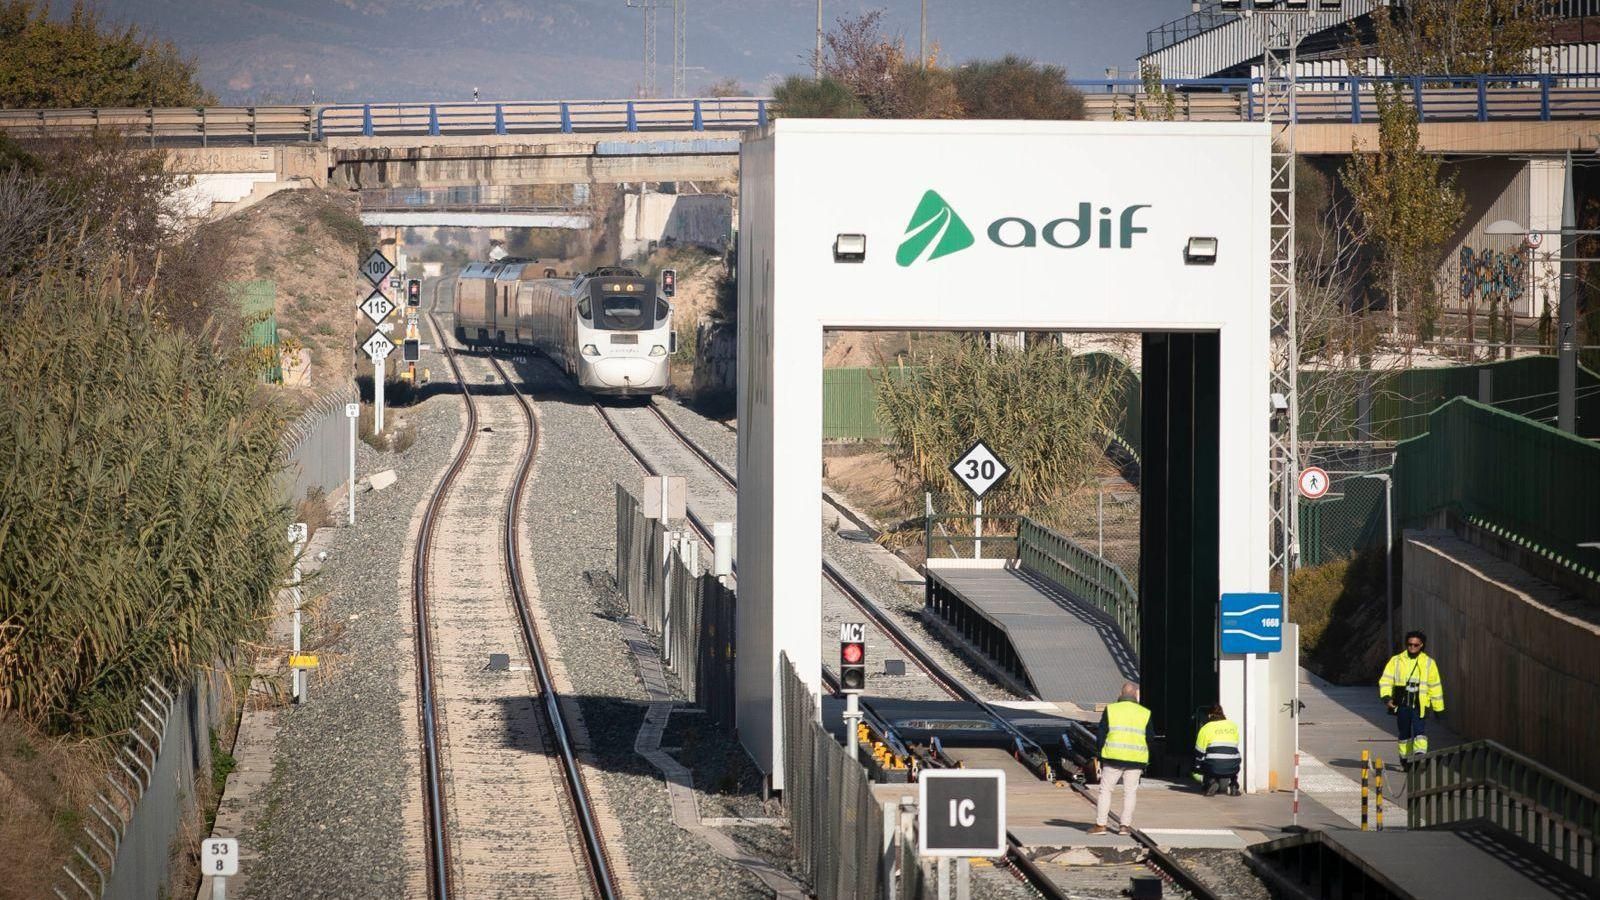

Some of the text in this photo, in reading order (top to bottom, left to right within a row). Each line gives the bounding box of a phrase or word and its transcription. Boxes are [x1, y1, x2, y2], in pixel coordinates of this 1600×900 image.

[987, 202, 1152, 249] adif
[368, 261, 386, 274] 100
[368, 301, 387, 314] 115
[965, 459, 995, 480] 30
[840, 623, 865, 643] MC1
[949, 798, 975, 827] IC
[211, 843, 229, 855] 53
[215, 859, 224, 871] 8
